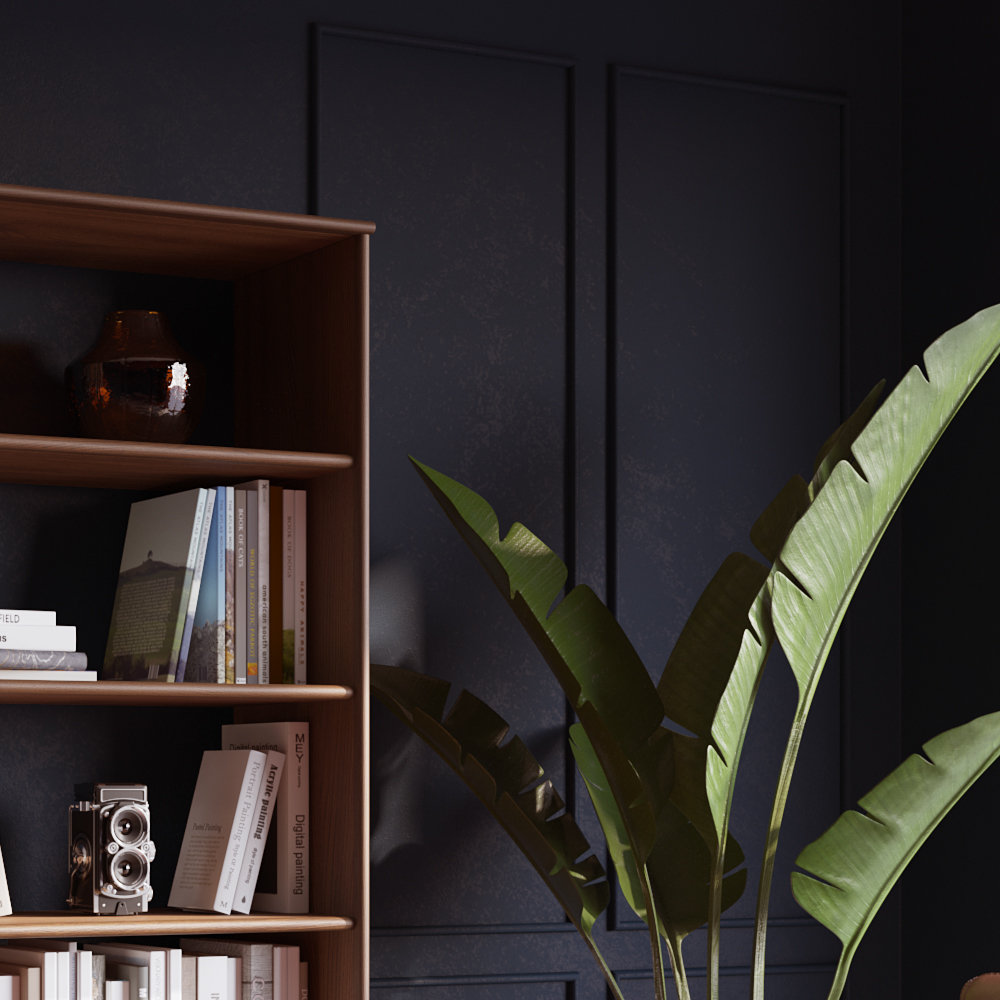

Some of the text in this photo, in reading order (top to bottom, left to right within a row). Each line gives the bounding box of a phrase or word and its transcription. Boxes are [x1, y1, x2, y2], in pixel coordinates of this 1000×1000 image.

[238, 534, 244, 544] OF
[287, 541, 292, 552] OF
[249, 578, 255, 590] OF
[246, 762, 261, 798] Portrait
[254, 764, 278, 840] Acrylic painting
[233, 802, 252, 842] Painting
[292, 814, 305, 895] Digital painting
